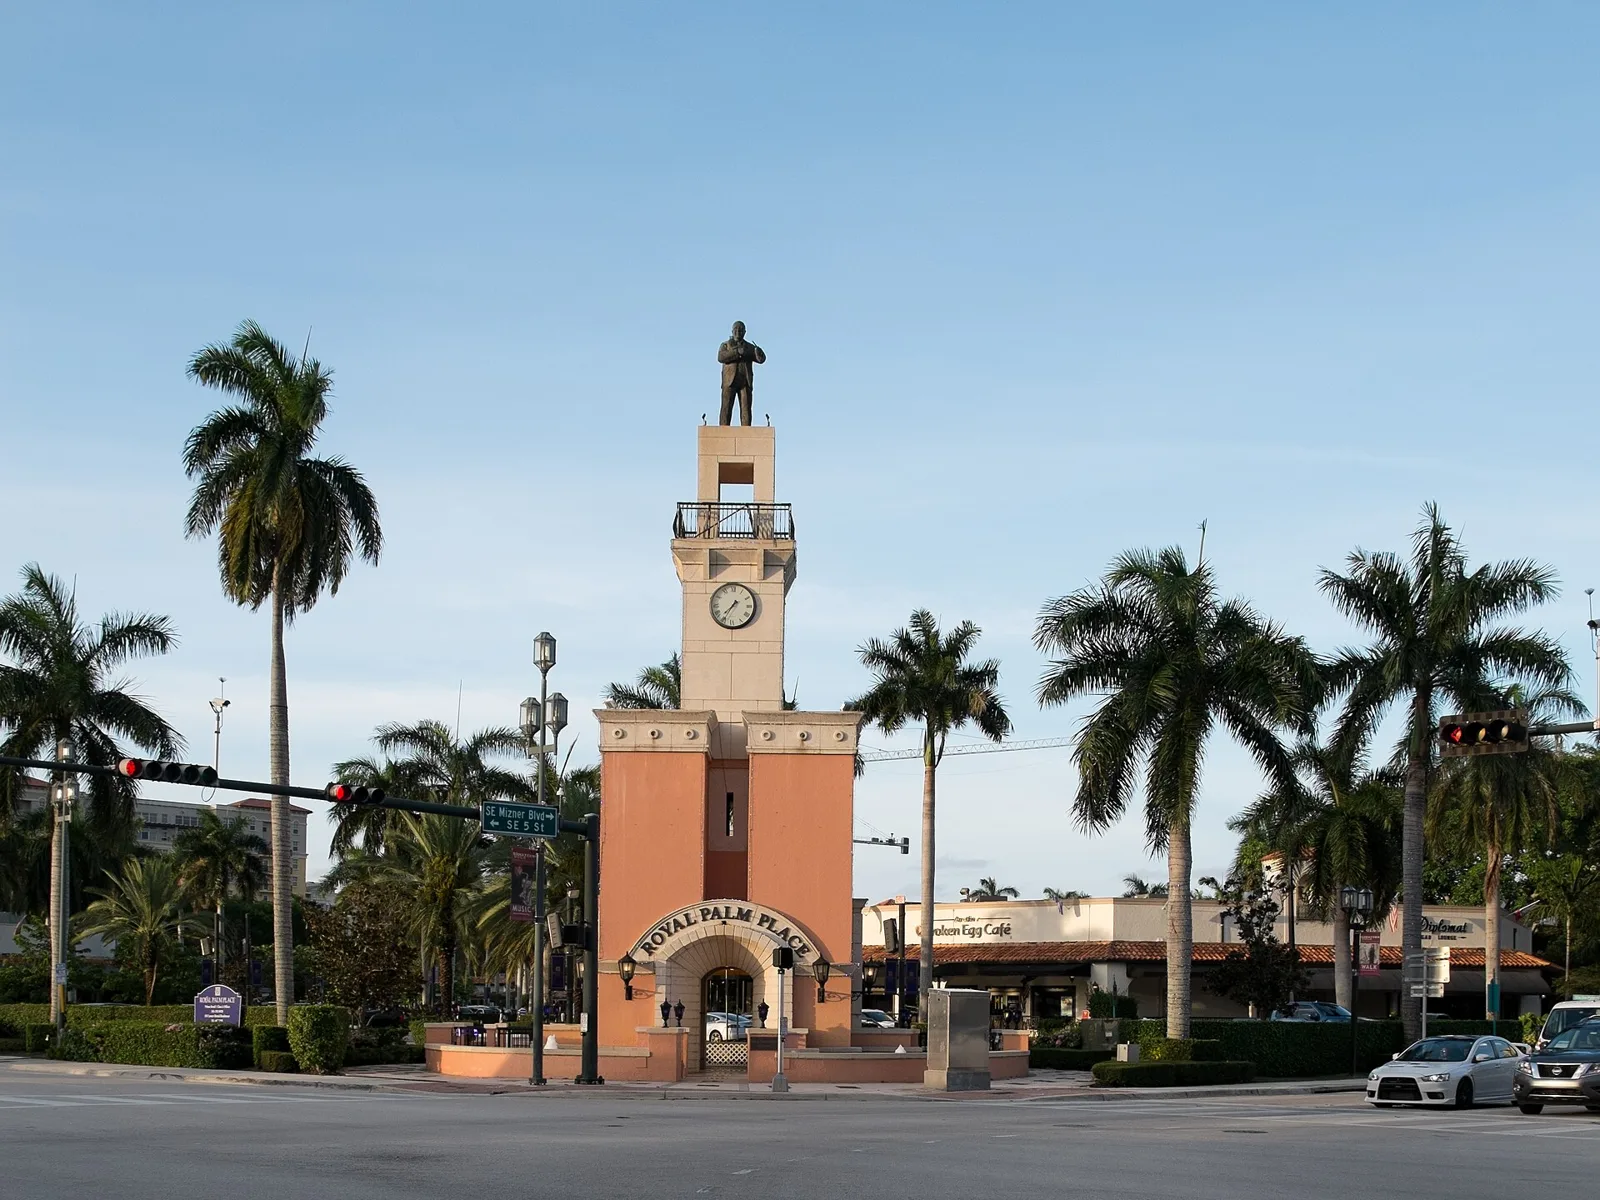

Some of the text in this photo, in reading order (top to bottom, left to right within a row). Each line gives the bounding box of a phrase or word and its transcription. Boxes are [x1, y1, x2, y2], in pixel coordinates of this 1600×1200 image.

[485, 806, 545, 821] SE Mizner Blvd
[506, 820, 545, 832] SE 5 St
[512, 904, 532, 913] MUSIC
[641, 906, 813, 958] ROYAL PALM PLACE
[962, 924, 982, 938] Egg
[984, 923, 1012, 937] Café
[1421, 916, 1467, 934] Diplomat
